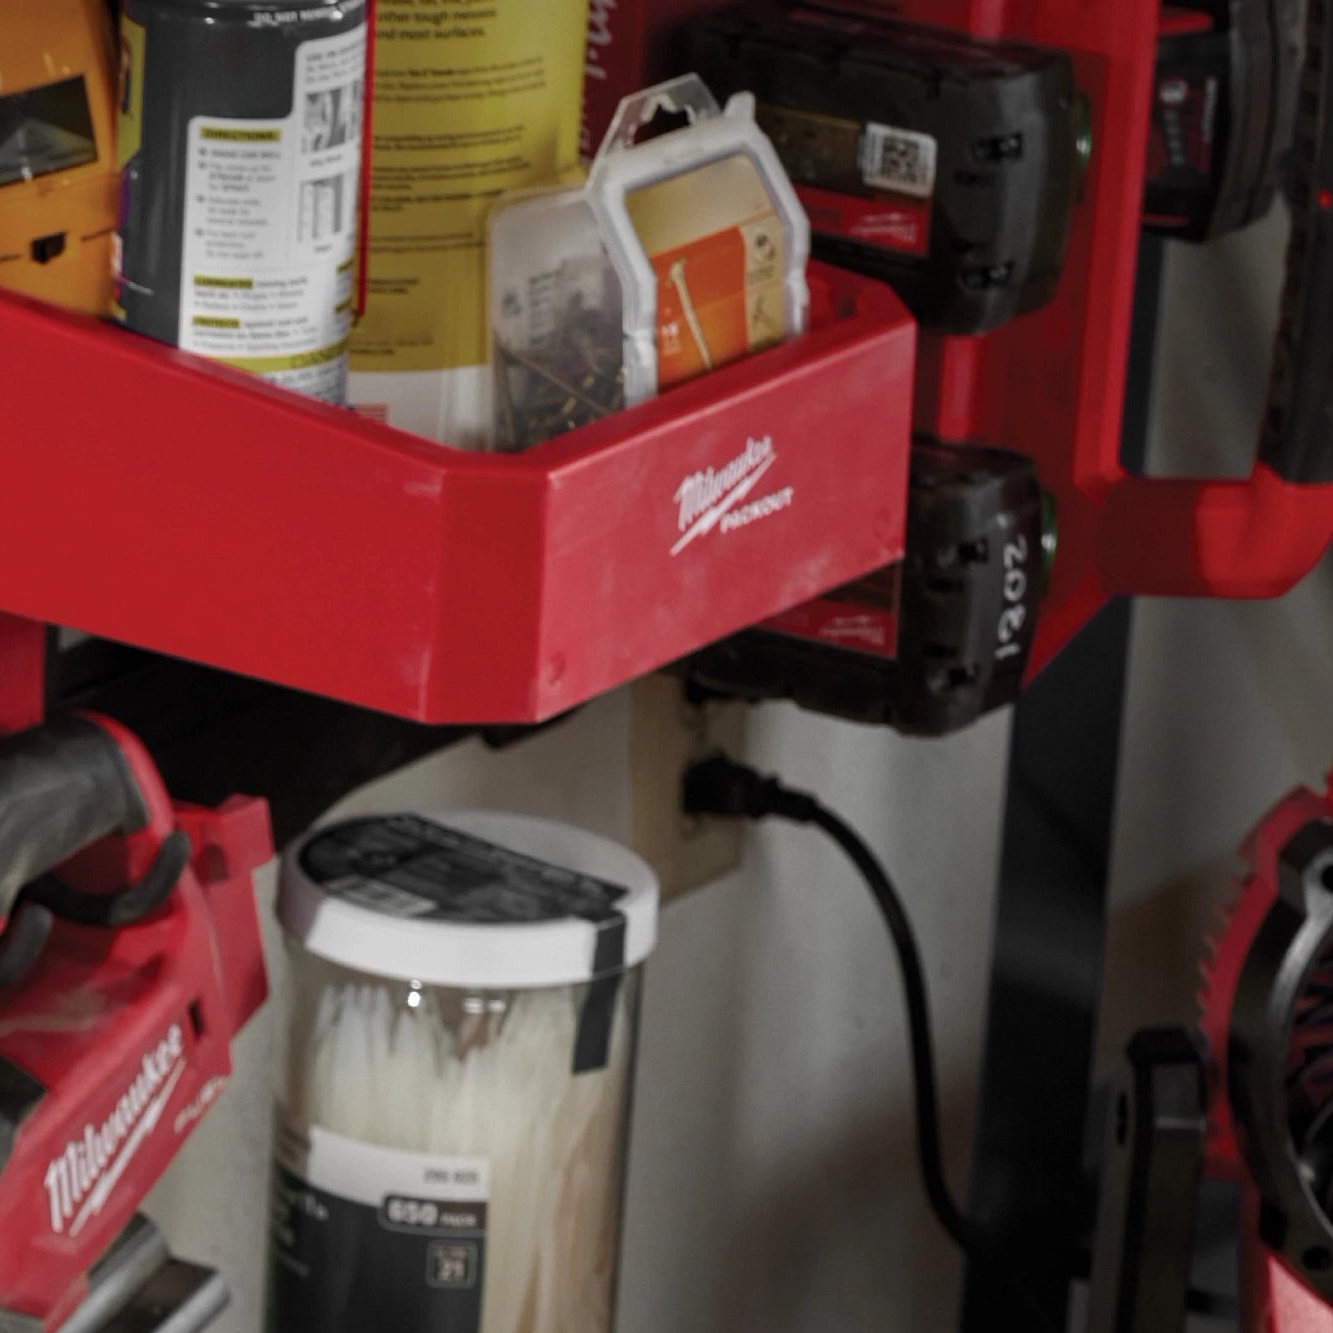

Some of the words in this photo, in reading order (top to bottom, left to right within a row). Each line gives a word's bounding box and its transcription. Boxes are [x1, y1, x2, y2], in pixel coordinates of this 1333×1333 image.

[673, 435, 773, 531] Milwaukee
[720, 485, 793, 534] PACKOUT
[44, 1024, 182, 1233] Milwaukee
